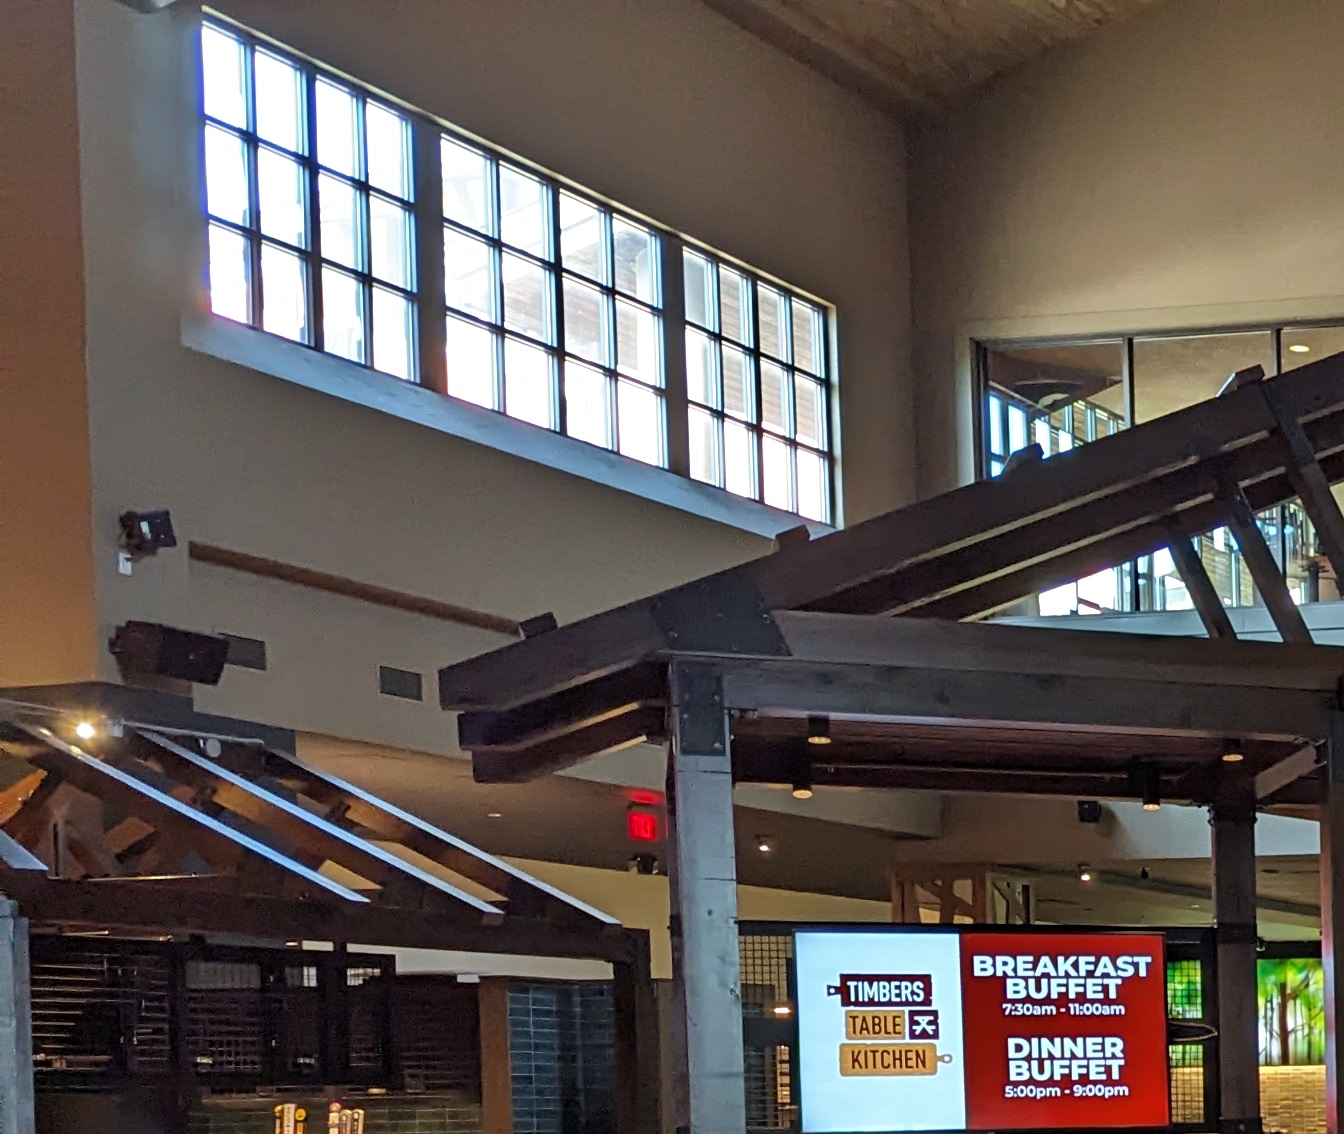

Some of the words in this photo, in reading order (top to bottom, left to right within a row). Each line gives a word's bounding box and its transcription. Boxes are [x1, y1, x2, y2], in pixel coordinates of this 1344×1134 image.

[972, 955, 1152, 977] BREAKFAST
[846, 980, 925, 1002] TIMBERS
[1006, 978, 1122, 1000] BUFFET
[1002, 1003, 1057, 1016] 7:30am
[1068, 1003, 1125, 1016] 11:00am
[849, 1014, 902, 1036] TABLE
[1007, 1037, 1125, 1059] DINNER
[851, 1049, 927, 1070] KITCHEN
[1009, 1059, 1125, 1081] BUFFET
[1004, 1085, 1061, 1099] 5:00pm
[1073, 1084, 1129, 1098] 9:00pm
